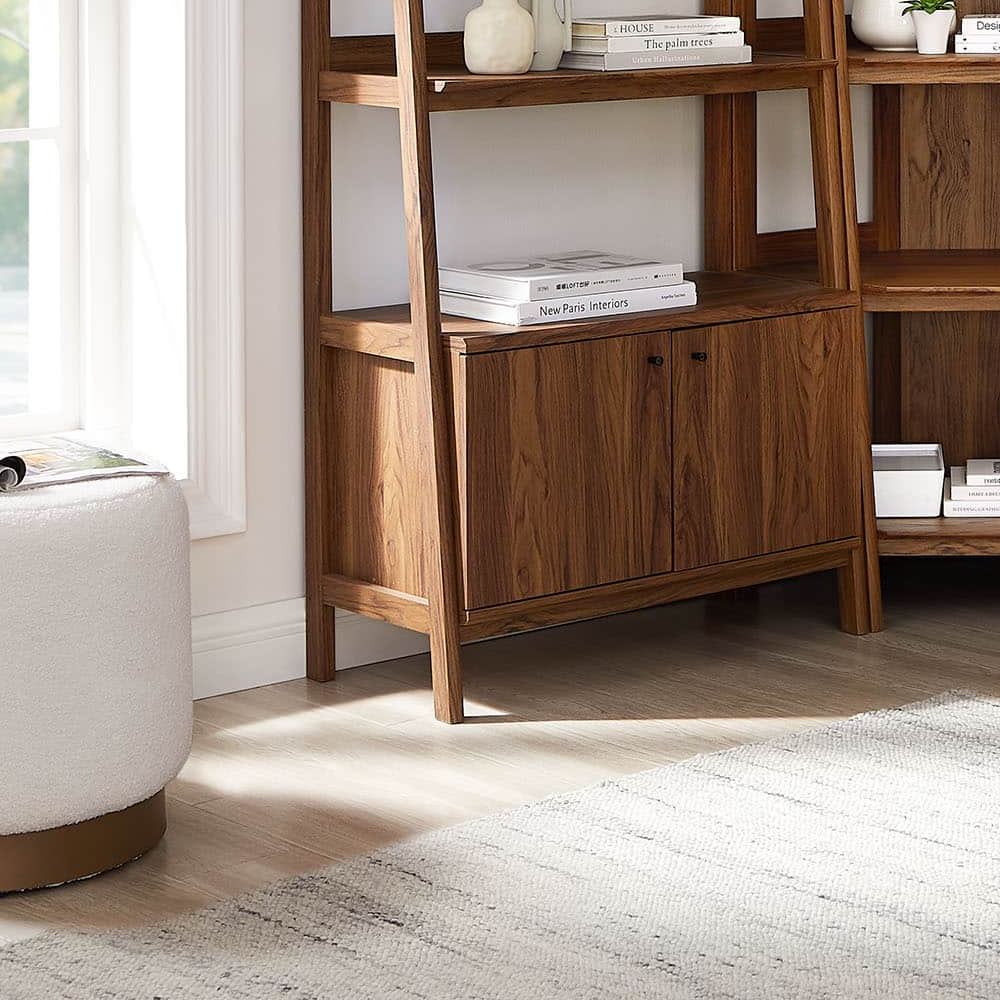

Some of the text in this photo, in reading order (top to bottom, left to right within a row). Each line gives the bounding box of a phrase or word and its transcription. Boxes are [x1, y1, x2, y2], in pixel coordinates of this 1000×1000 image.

[620, 23, 654, 33] HOUSE
[644, 37, 713, 51] The palm trees
[540, 299, 629, 317] New Paris Interiors
